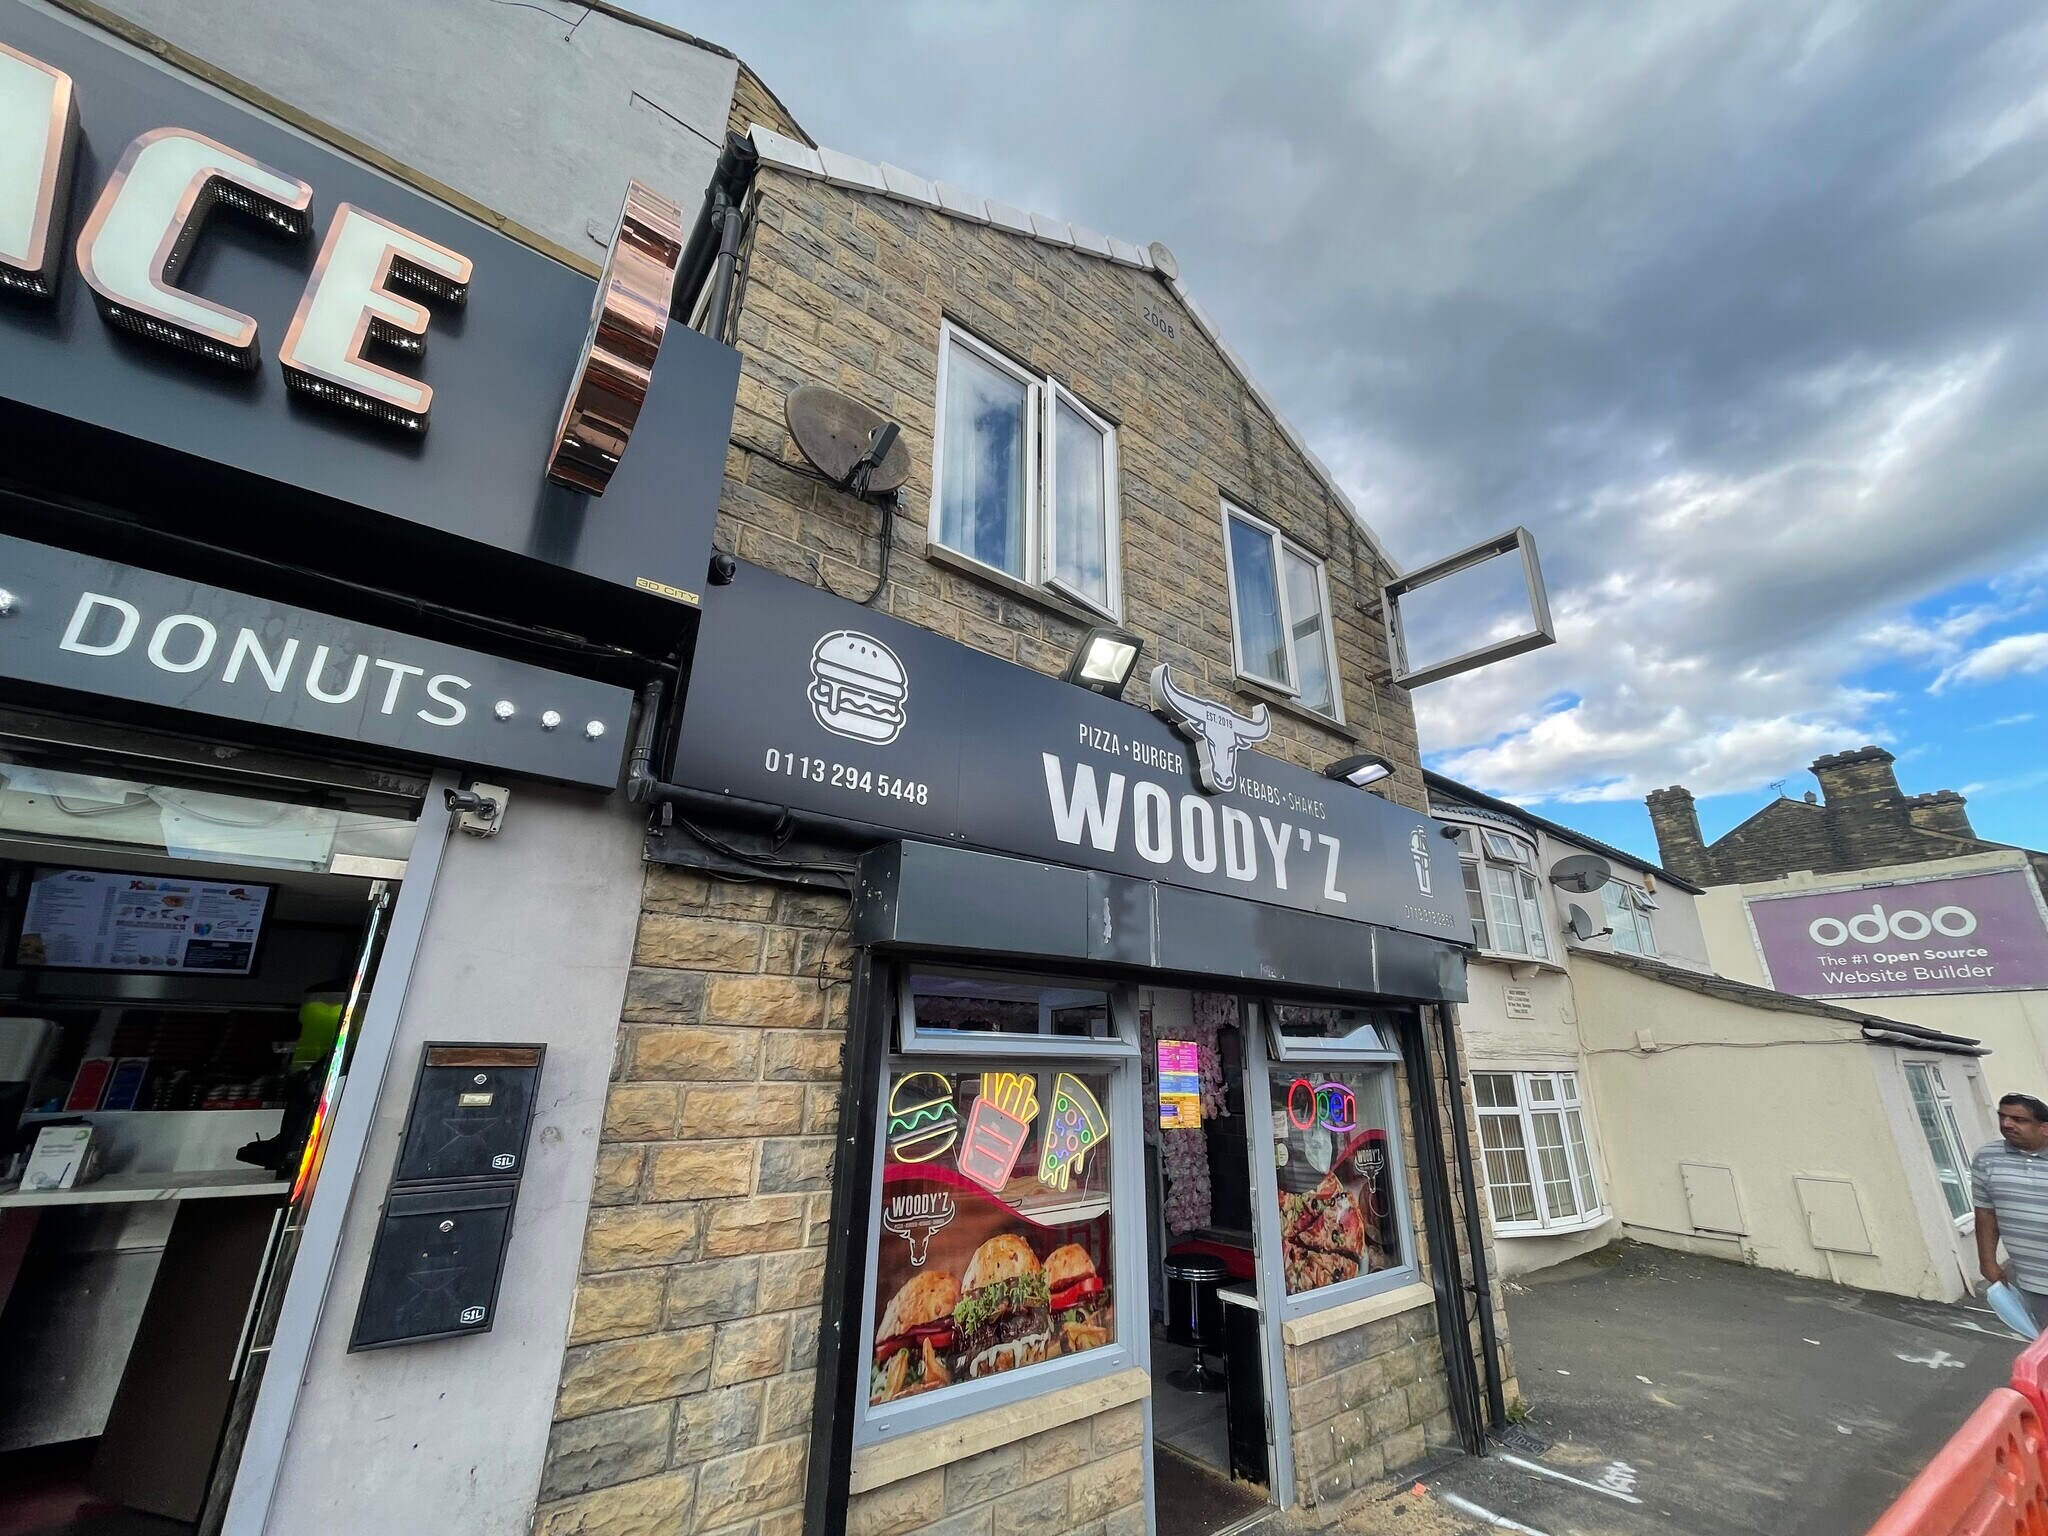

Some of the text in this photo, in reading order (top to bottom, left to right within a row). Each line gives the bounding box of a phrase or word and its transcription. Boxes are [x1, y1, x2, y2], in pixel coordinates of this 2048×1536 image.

[1143, 306, 1174, 339] 2008
[637, 579, 698, 602] 3D CITY
[58, 590, 472, 727] DONUTS
[1206, 710, 1233, 730] EST. 2019
[765, 748, 929, 806] 0113 294 5448
[1079, 723, 1326, 820] PIZZA BURGER KEBABS SHAKES
[1042, 751, 1348, 904] WOODY'Z
[1808, 903, 1978, 947] odoo
[1817, 946, 1989, 968] The #1 Open Source
[1822, 964, 1996, 985] Website Builder
[1287, 1077, 1357, 1131] Open
[892, 1191, 949, 1218] WOODY'Z
